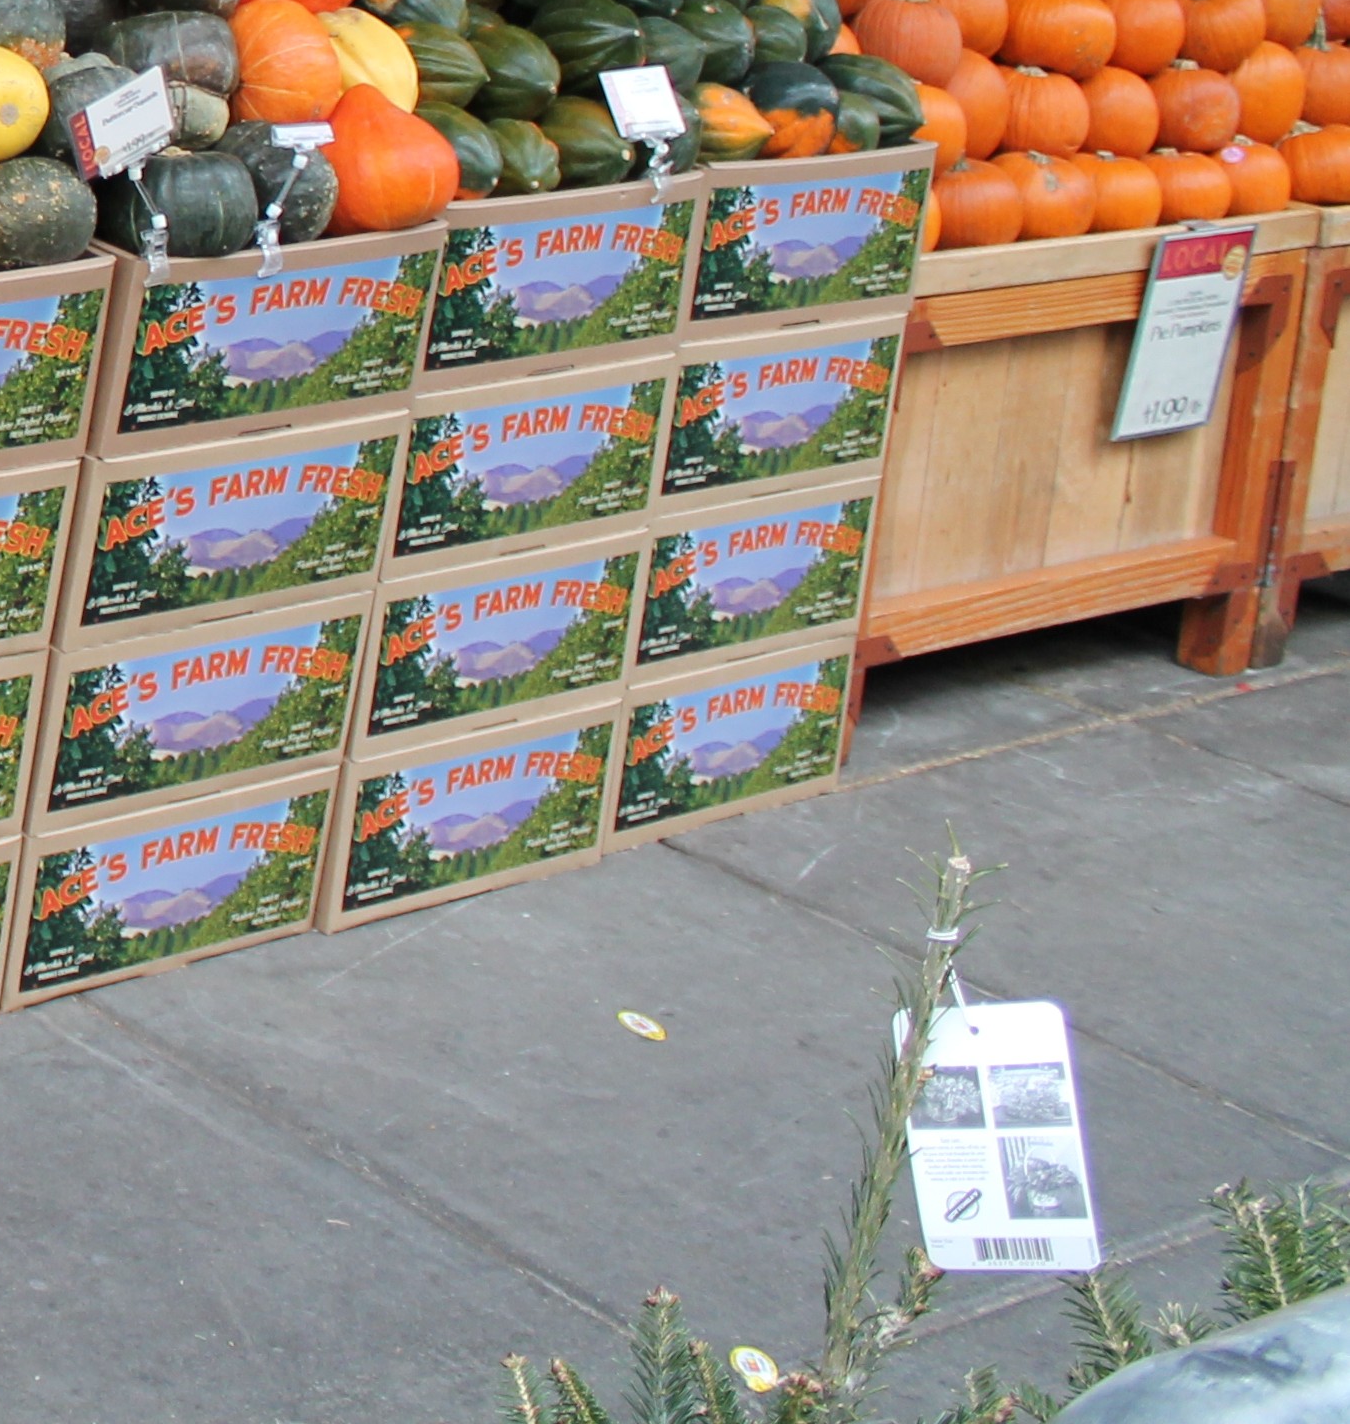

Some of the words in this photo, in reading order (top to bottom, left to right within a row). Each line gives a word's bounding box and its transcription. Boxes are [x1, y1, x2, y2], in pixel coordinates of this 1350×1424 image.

[788, 188, 849, 218] FARM
[854, 189, 919, 230] FRESH
[534, 224, 602, 259] FARM
[609, 225, 683, 266] FRESH
[142, 293, 234, 356] ACE'S
[248, 277, 329, 315] FARM
[336, 278, 423, 320] FRESH
[757, 357, 817, 391] FARM
[823, 358, 889, 395] FRESH
[501, 405, 570, 443] FARM
[577, 405, 654, 442] FRESH
[103, 486, 193, 550] ACE'S
[208, 466, 288, 506] FARM
[296, 466, 384, 503] FRESH
[728, 522, 787, 558] FARM
[793, 522, 861, 555] FRESH
[473, 581, 542, 621] FARM
[549, 581, 627, 615] FRESH
[69, 672, 156, 737] ACE'S
[171, 648, 250, 691] FARM
[258, 647, 348, 681] FRESH
[706, 685, 765, 723] FARM
[772, 684, 839, 714] FRESH
[447, 754, 515, 795] FARM
[523, 753, 601, 783] FRESH
[39, 852, 126, 919] ACE'S
[141, 826, 219, 870] FARM
[228, 824, 315, 855] FRESH
